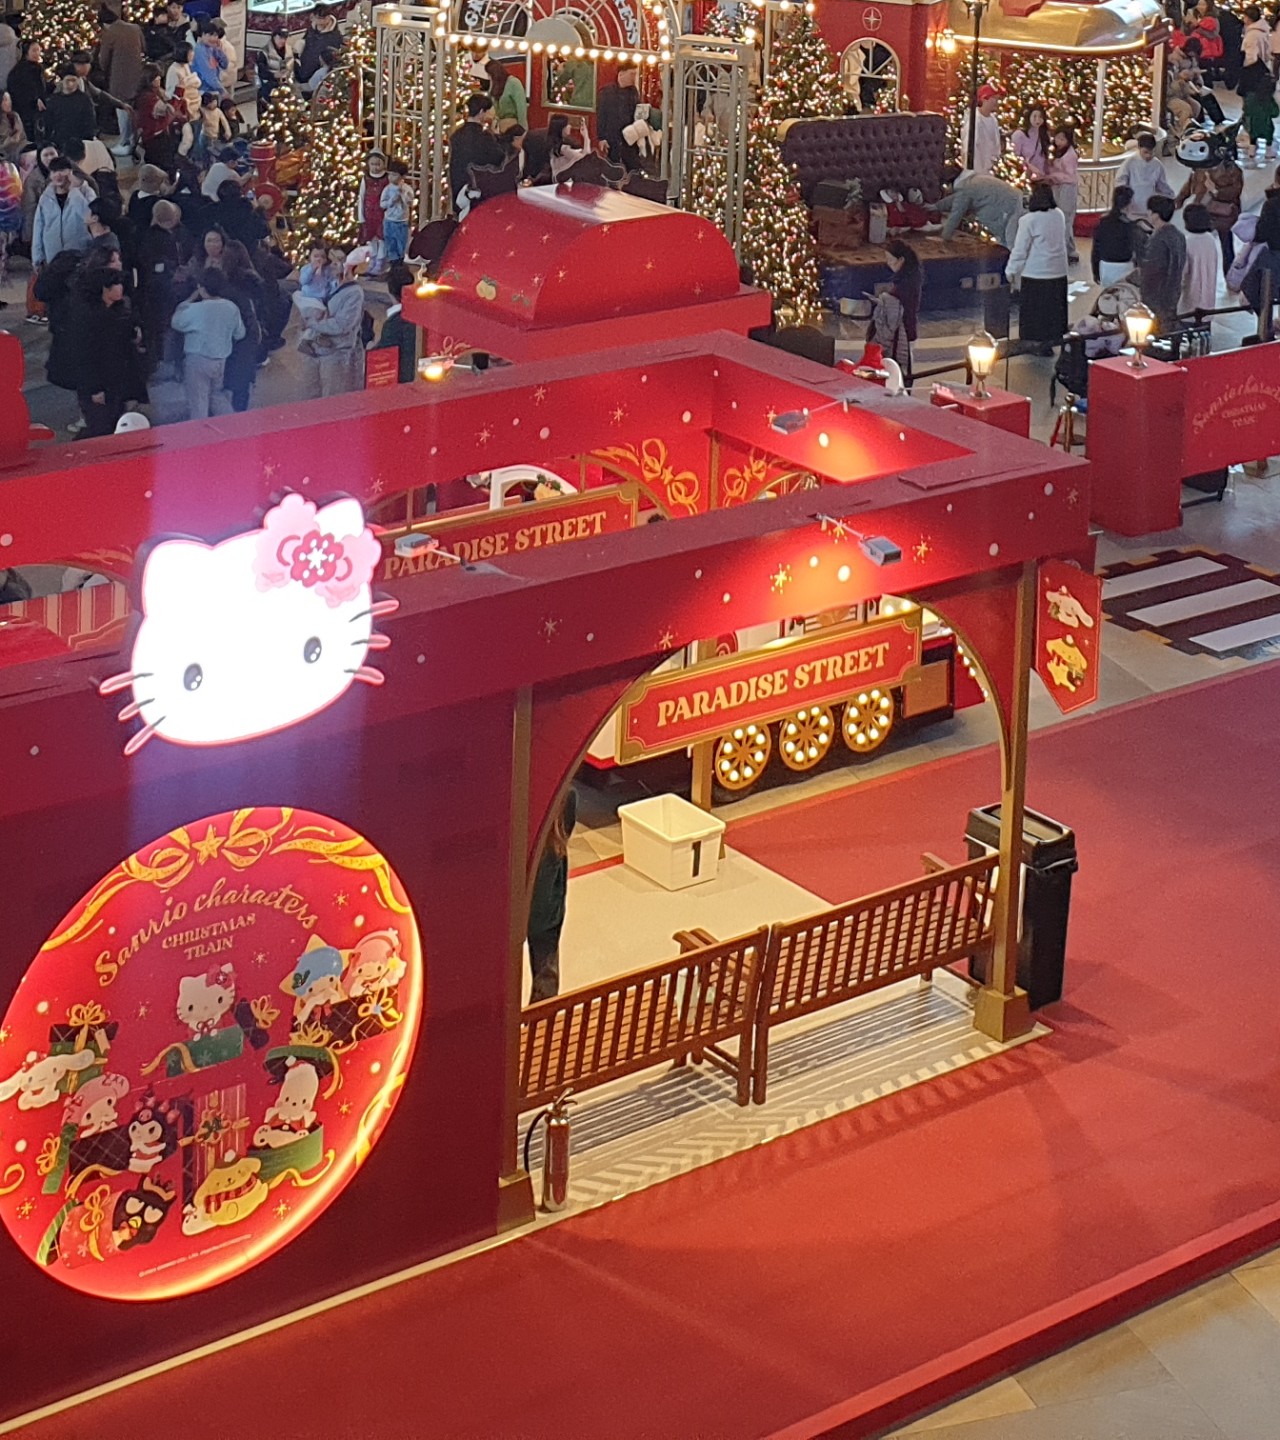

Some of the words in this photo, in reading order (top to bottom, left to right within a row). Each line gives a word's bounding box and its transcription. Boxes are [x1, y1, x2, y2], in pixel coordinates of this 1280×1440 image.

[515, 510, 608, 552] STREET
[657, 668, 790, 727] PARADISE
[793, 641, 890, 690] STREET
[691, 839, 703, 879] 1
[94, 896, 188, 987] Sanrio
[193, 876, 319, 929] characters
[161, 912, 257, 950] CHRISTMAS
[183, 935, 235, 961] TRAIN
